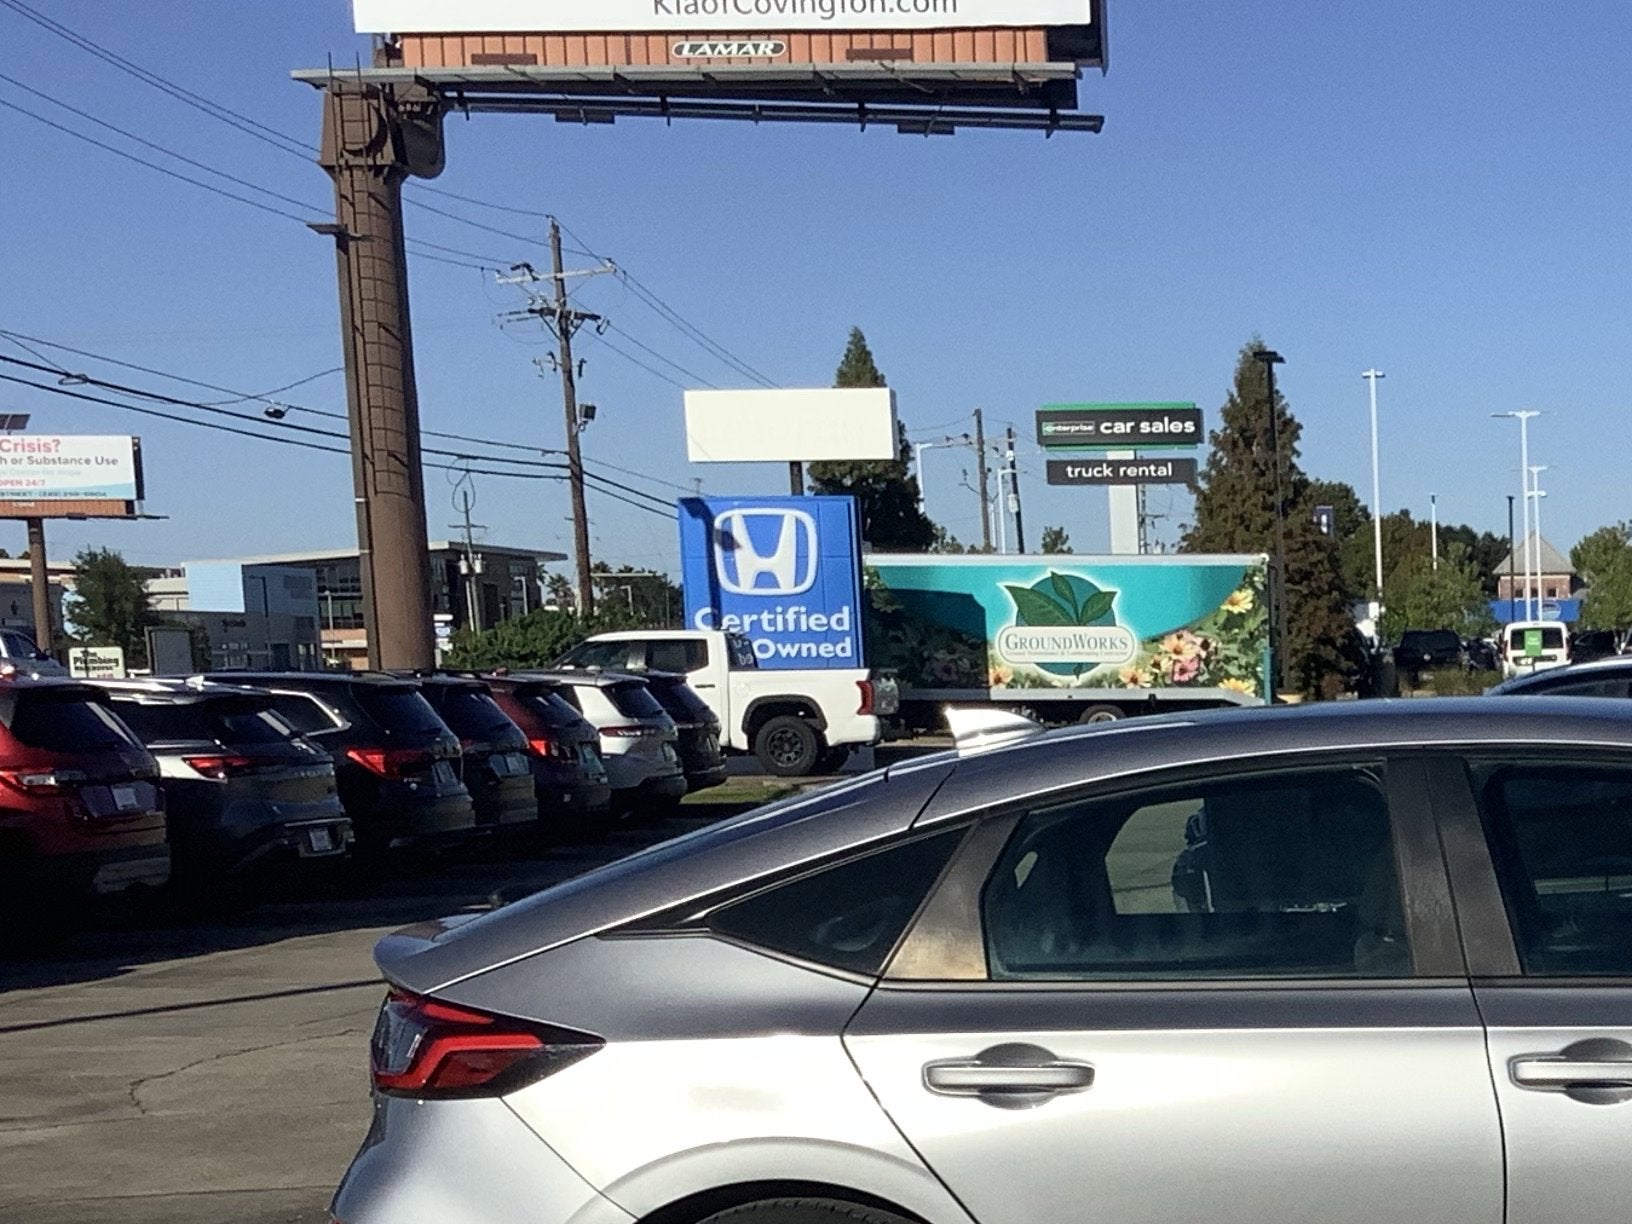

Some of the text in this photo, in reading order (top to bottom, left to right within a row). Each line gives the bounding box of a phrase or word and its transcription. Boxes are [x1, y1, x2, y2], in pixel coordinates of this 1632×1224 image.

[682, 43, 775, 56] LAMAR
[1100, 420, 1135, 433] car
[1139, 416, 1195, 433] sales
[0, 438, 61, 453] Crisis?
[11, 457, 23, 465] or
[27, 456, 91, 465] Substance
[95, 456, 118, 466] Use
[1066, 462, 1172, 477] truck rental
[694, 606, 850, 633] Certified
[752, 637, 852, 660] Owned
